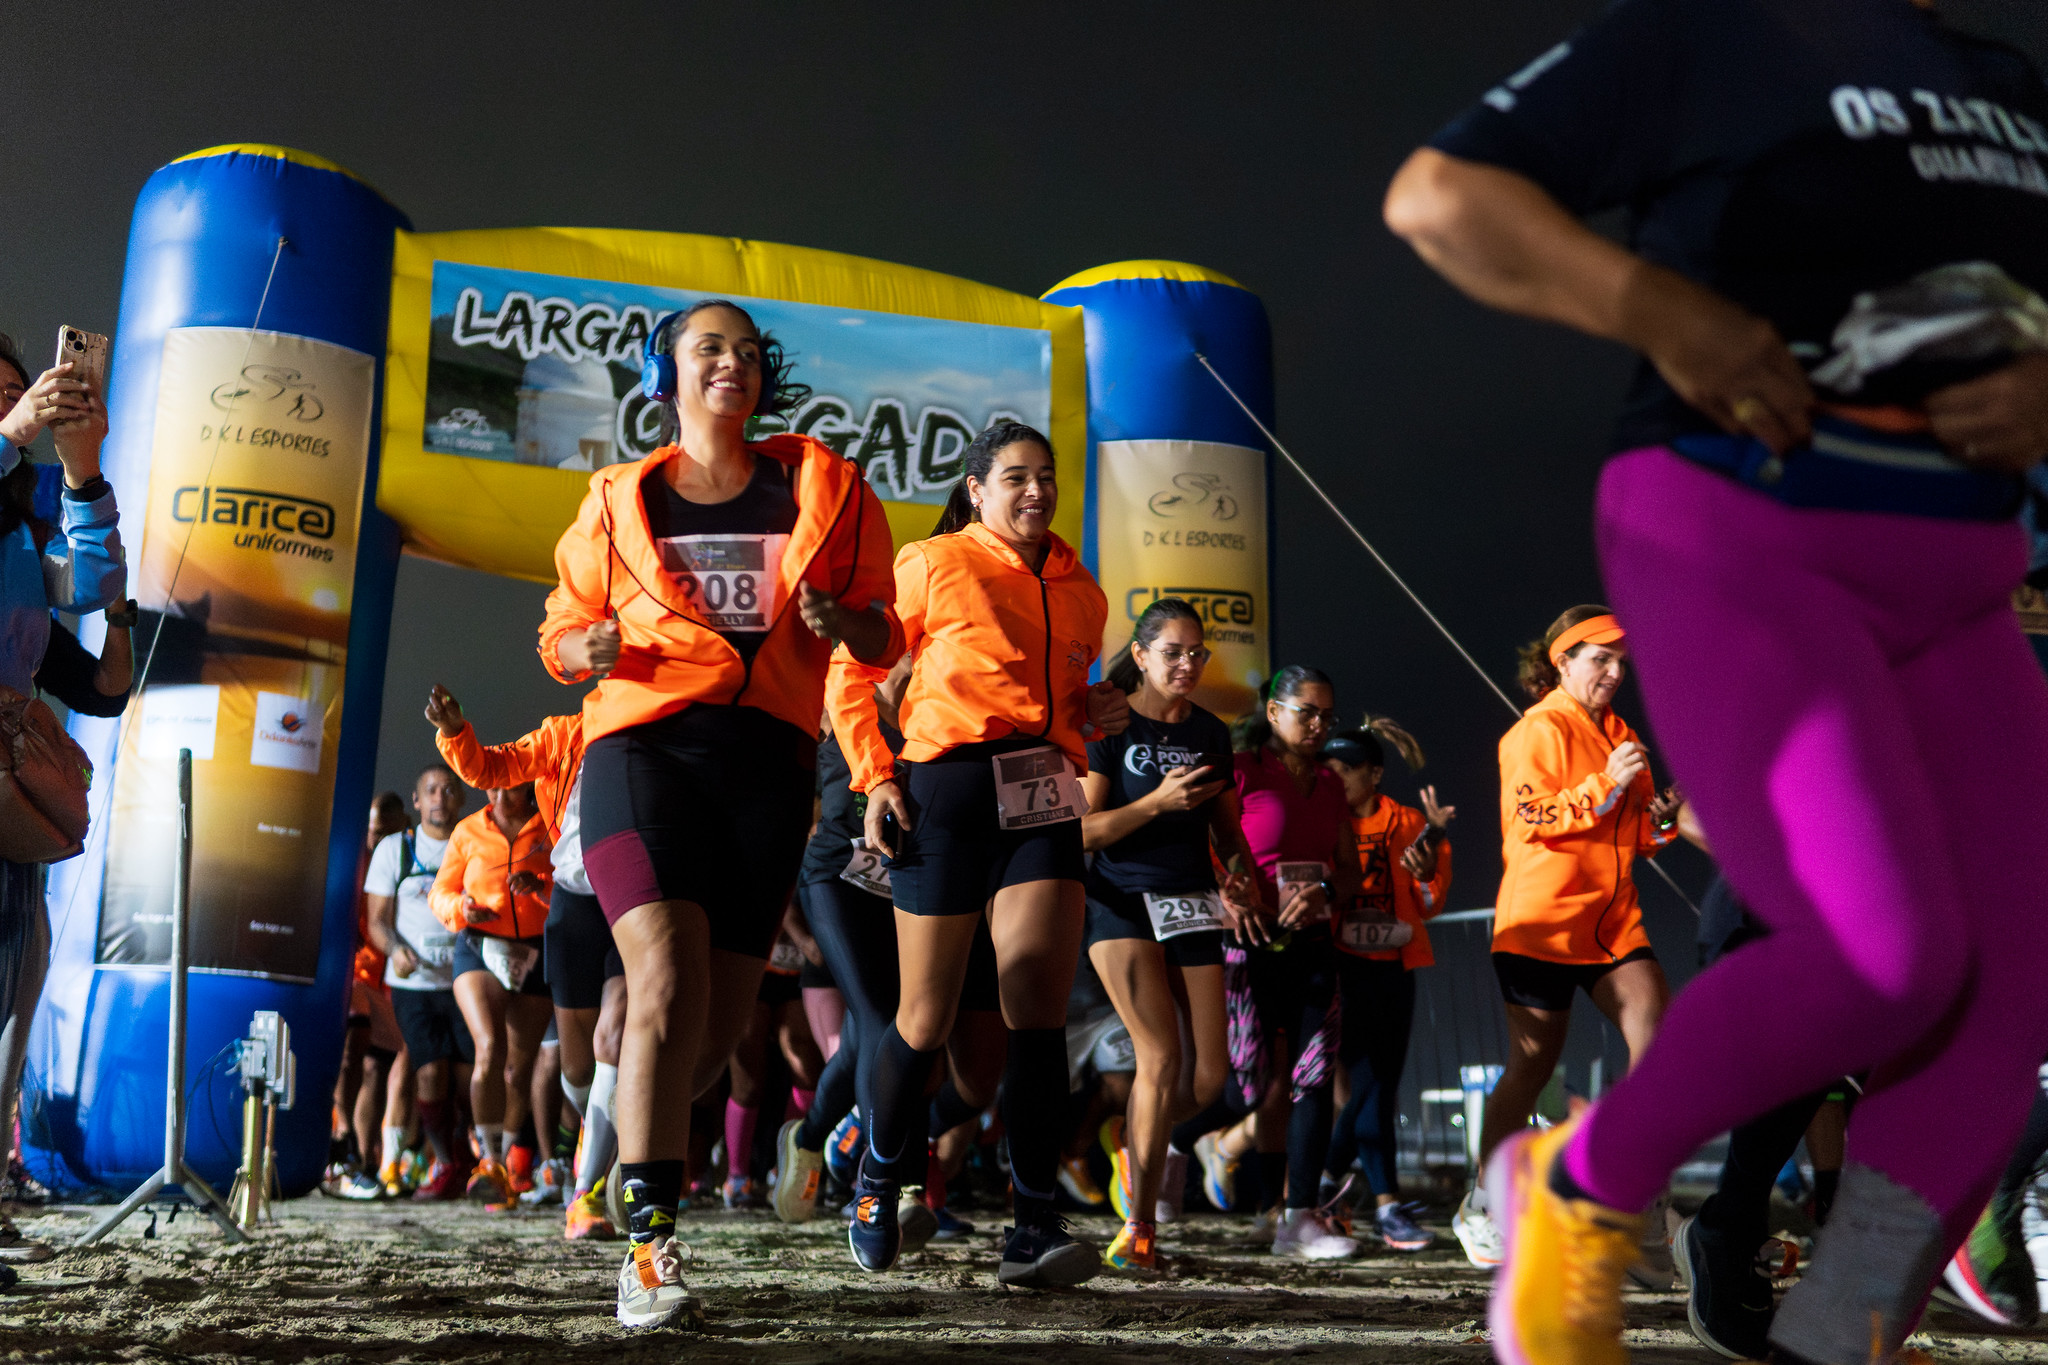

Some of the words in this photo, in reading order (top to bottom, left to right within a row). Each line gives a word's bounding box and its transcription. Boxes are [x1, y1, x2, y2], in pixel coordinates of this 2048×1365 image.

[1830, 85, 1910, 139] OS
[201, 425, 211, 440] D
[219, 425, 231, 441] K
[236, 426, 244, 443] L
[250, 427, 331, 457] ESPORTES
[172, 486, 335, 539] Clarice
[233, 532, 334, 562] uniformes
[1143, 530, 1153, 546] D
[1160, 530, 1170, 545] K
[1175, 531, 1182, 546] L
[1186, 530, 1246, 551] ESPORTES
[675, 573, 757, 611] 208
[1021, 777, 1060, 811] 73
[1159, 900, 1213, 923] 294
[1351, 925, 1394, 943] 107
